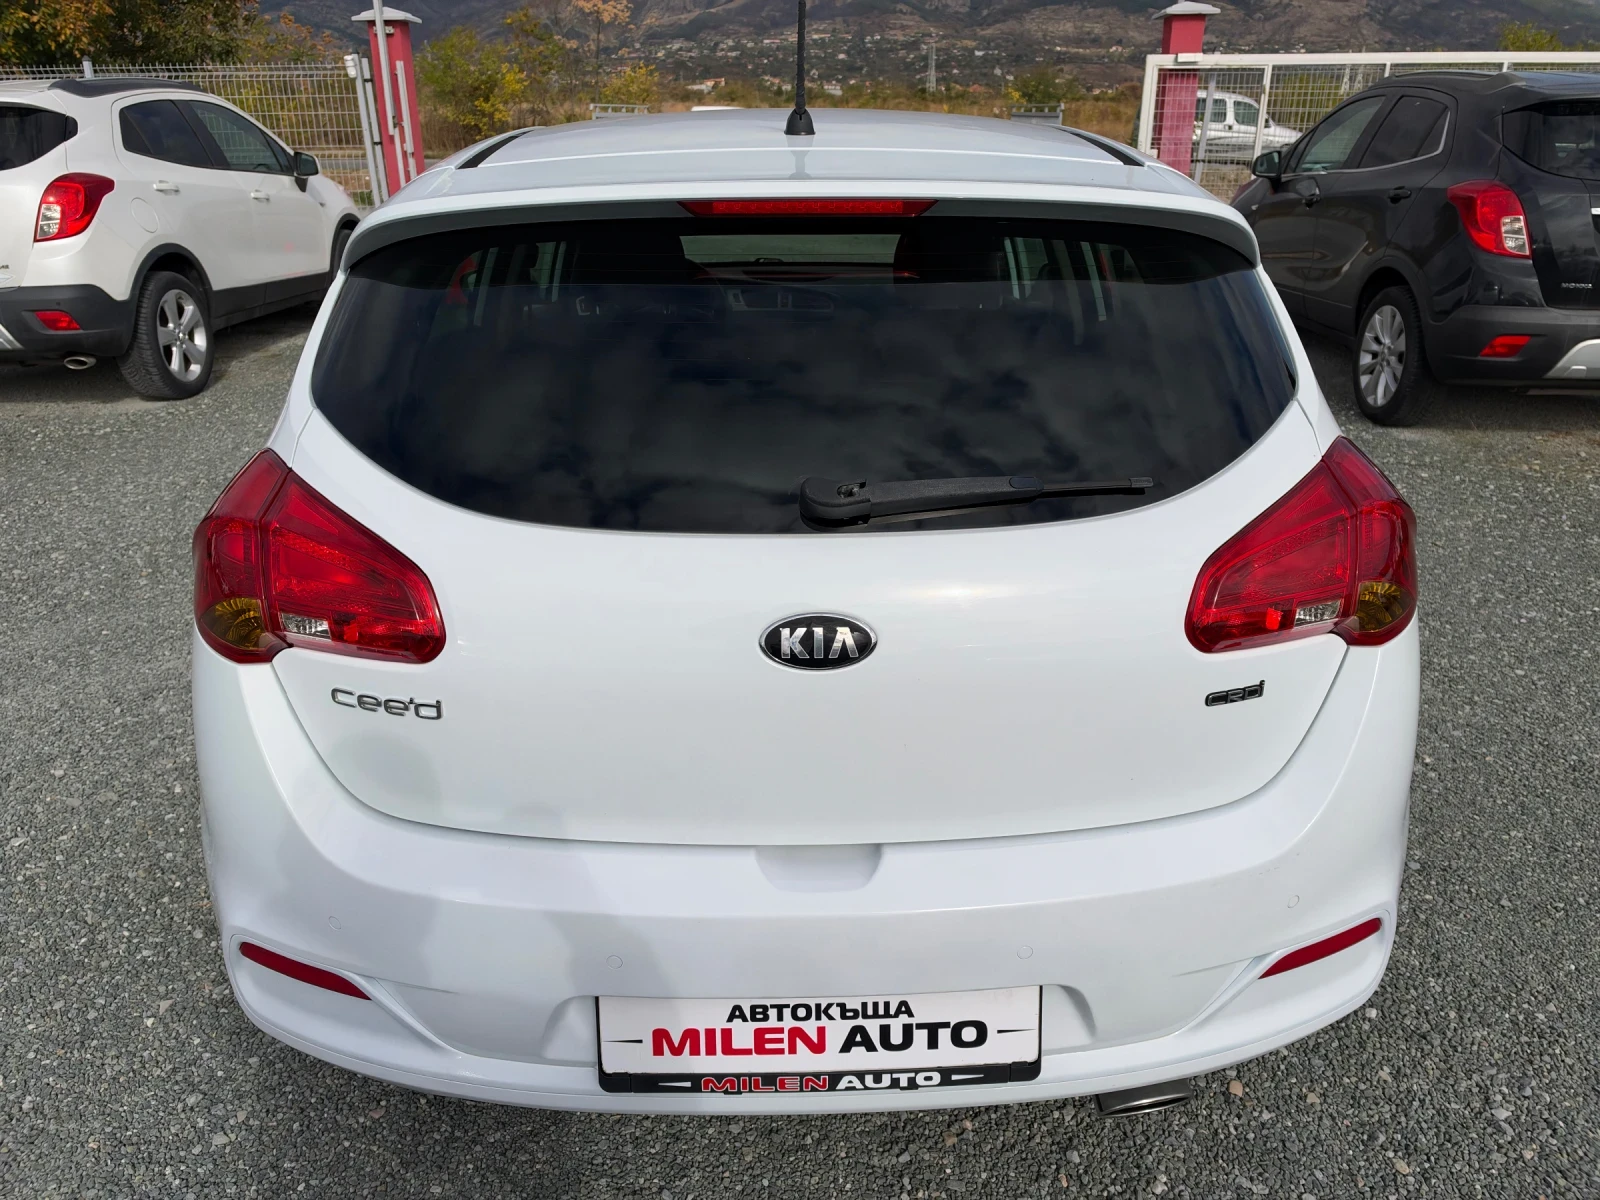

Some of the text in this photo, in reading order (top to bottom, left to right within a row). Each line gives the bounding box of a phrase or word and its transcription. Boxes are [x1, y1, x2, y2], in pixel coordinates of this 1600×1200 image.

[780, 626, 859, 659] KIA
[651, 1020, 988, 1057] MILEN AUTO
[701, 1071, 941, 1092] MILEN AUTO
